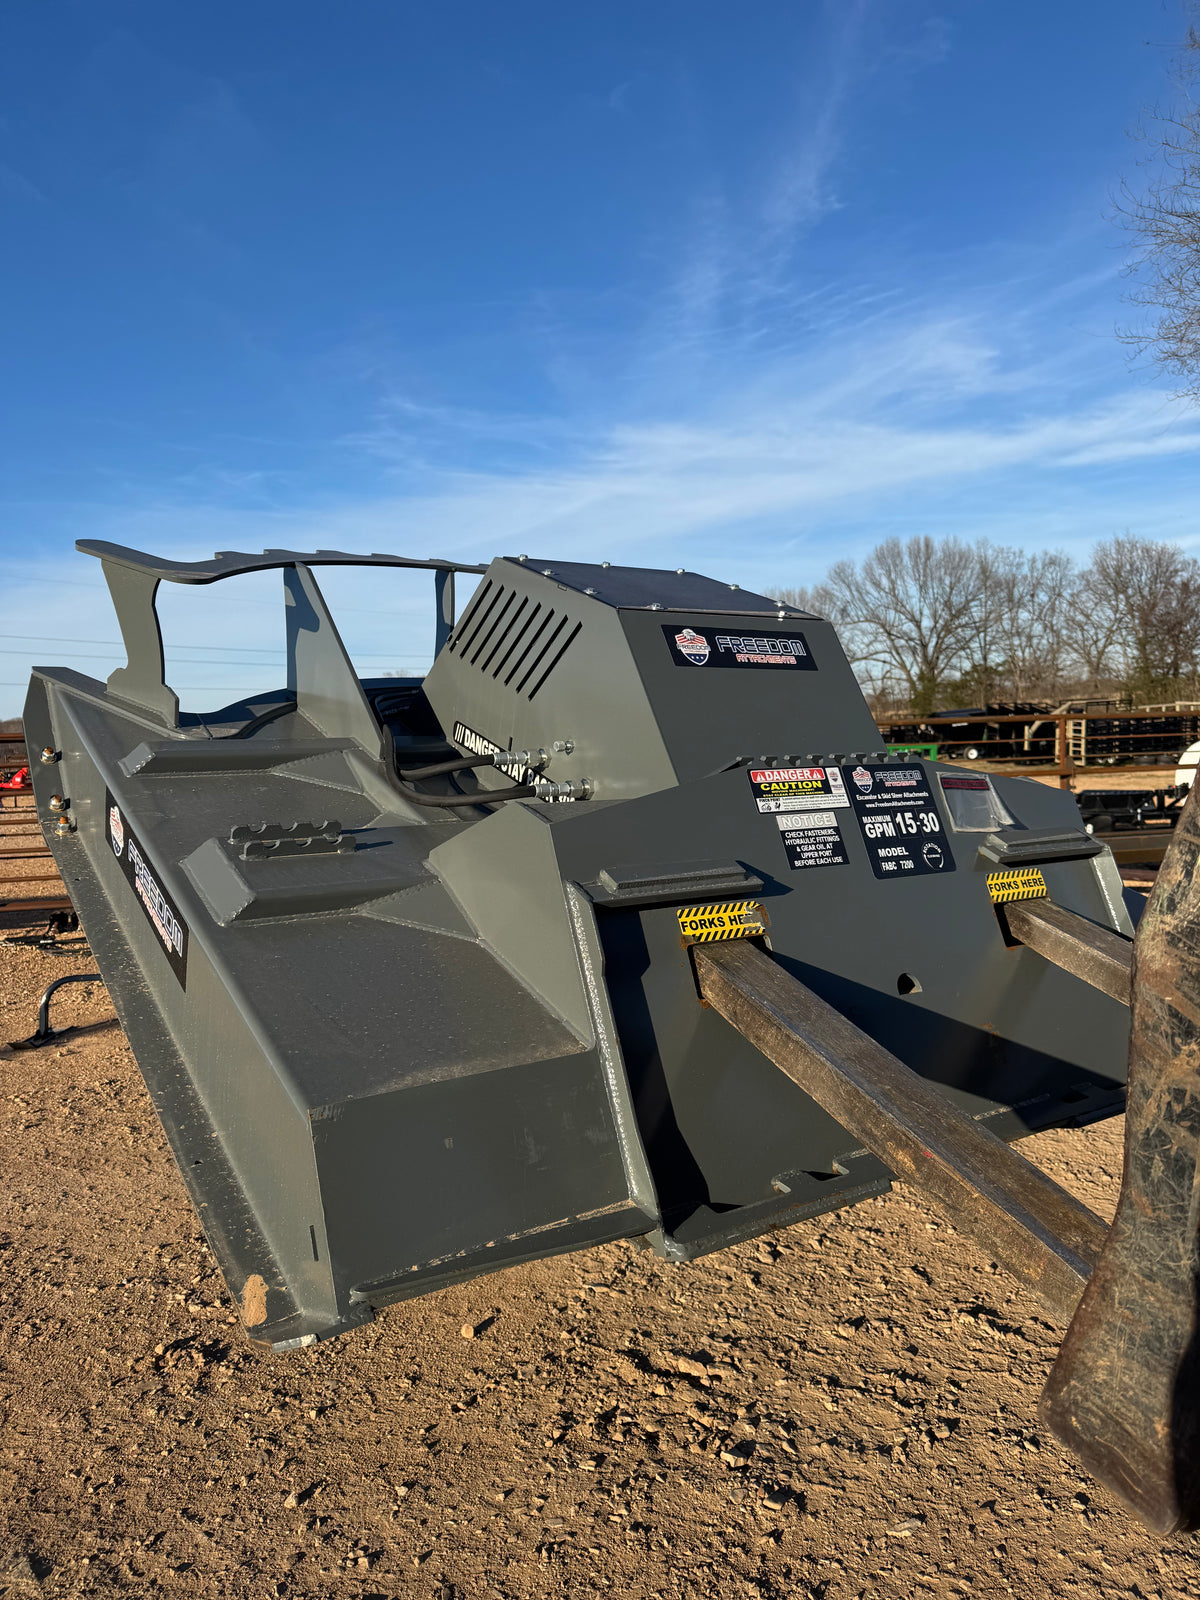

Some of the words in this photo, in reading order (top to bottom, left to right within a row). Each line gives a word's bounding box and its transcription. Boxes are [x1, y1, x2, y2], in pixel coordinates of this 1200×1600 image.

[715, 635, 806, 656] FREEDOM
[736, 653, 797, 665] ATTACHMENTS
[765, 769, 811, 781] DANGER
[874, 770, 922, 782] FREEDOM
[760, 781, 822, 791] CAUTION
[865, 800, 924, 808] www.FreedomAttachments.com
[781, 814, 832, 828] NOTICE
[862, 814, 891, 823] MAXIMUM
[865, 822, 896, 838] GPM
[896, 812, 939, 834] 15-30
[785, 837, 816, 845] HYDRAULIC
[877, 847, 909, 857] MODEL
[922, 842, 941, 853] ROTATION
[794, 858, 816, 867] BEFORE
[816, 857, 832, 865] EACH
[881, 861, 897, 871] FABC
[900, 860, 914, 869] 7200
[988, 880, 1019, 892] FORKS
[1020, 877, 1044, 888] HERE
[128, 838, 183, 957] FREEDOM
[681, 916, 725, 932] FORKS
